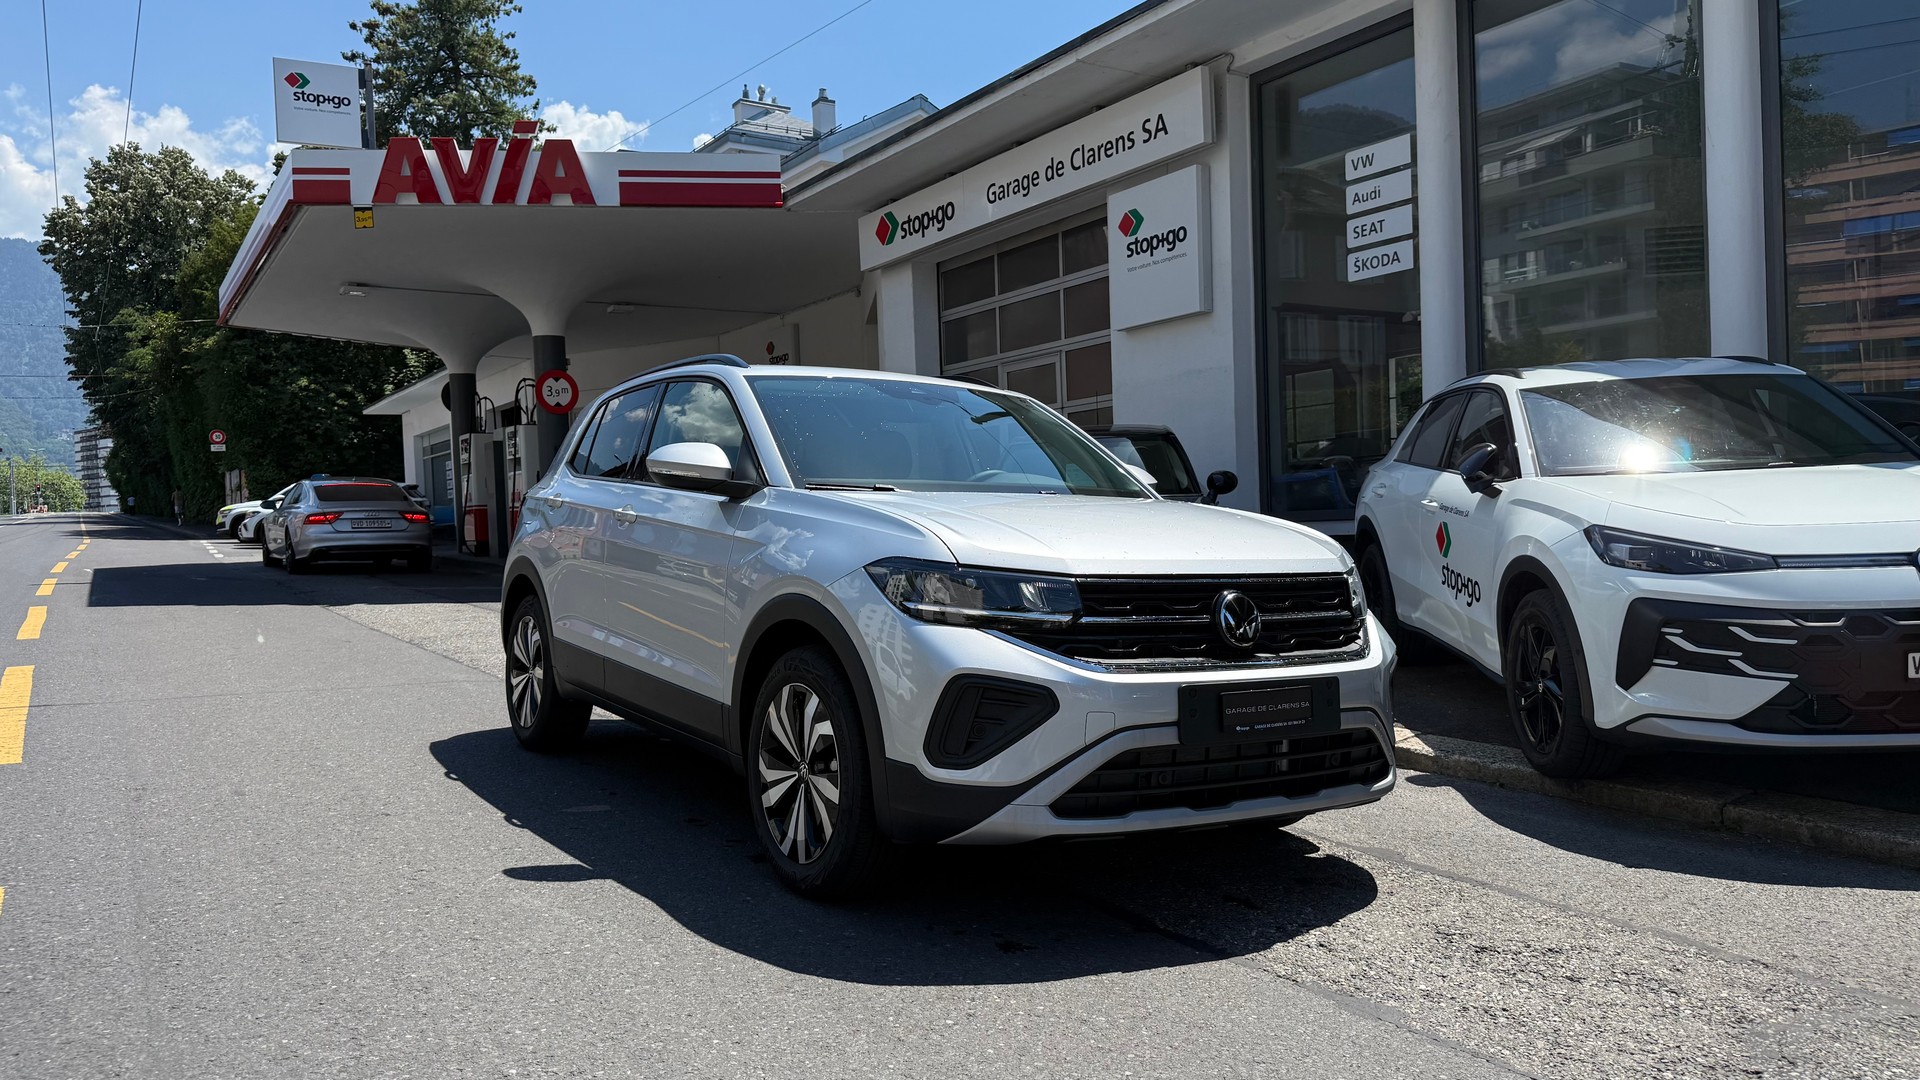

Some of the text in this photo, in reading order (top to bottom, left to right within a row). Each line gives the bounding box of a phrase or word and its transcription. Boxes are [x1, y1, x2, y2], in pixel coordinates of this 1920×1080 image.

[293, 90, 351, 109] stop+go
[372, 120, 597, 205] AVIA
[986, 113, 1169, 204] Garage de Clarens SA
[1351, 152, 1375, 171] VW
[1352, 185, 1381, 206] Audi
[900, 201, 955, 239] stop+go
[1353, 219, 1385, 239] SEAT
[1126, 225, 1187, 258] stop+go
[1354, 250, 1401, 273] ŠKODA
[1441, 562, 1481, 608] stop+go
[1225, 706, 1256, 715] GARAGE
[1268, 702, 1300, 711] CLARENS
